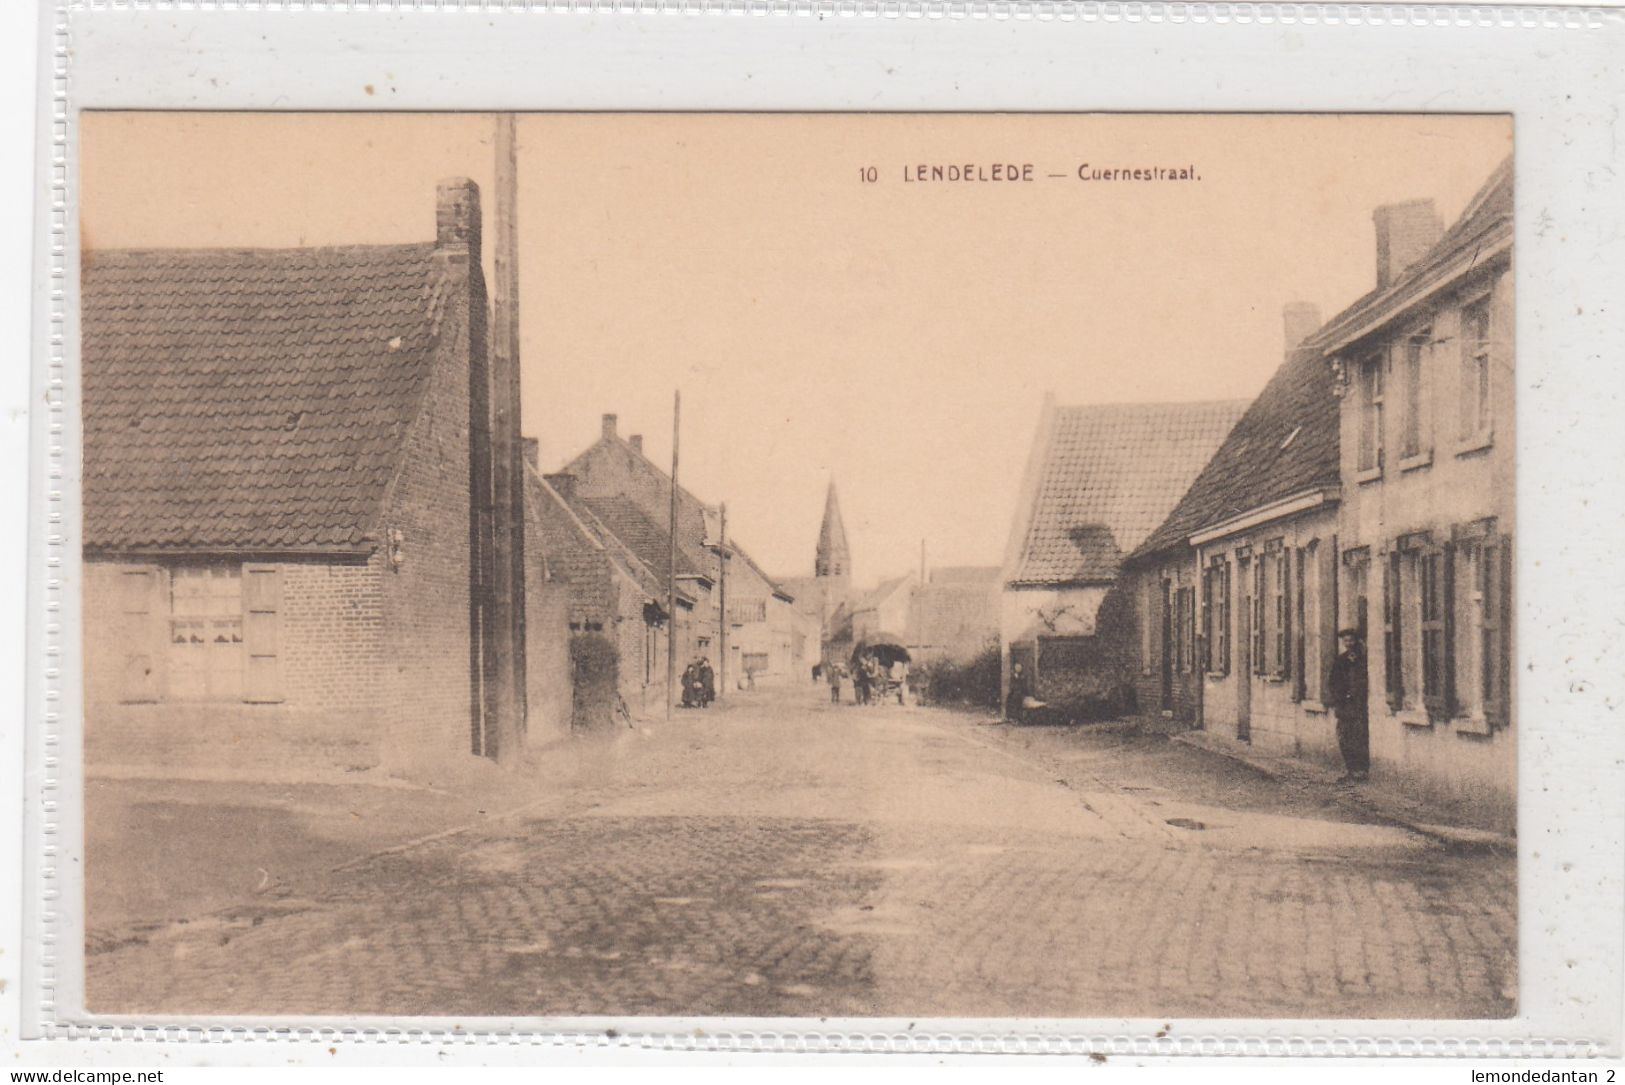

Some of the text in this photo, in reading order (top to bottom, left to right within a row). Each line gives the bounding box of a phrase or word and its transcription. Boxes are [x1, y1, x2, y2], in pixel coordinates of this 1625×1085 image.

[859, 166, 878, 183] 10
[904, 164, 1035, 183] LENDELEDE
[1078, 163, 1202, 182] Cuernestraat.
